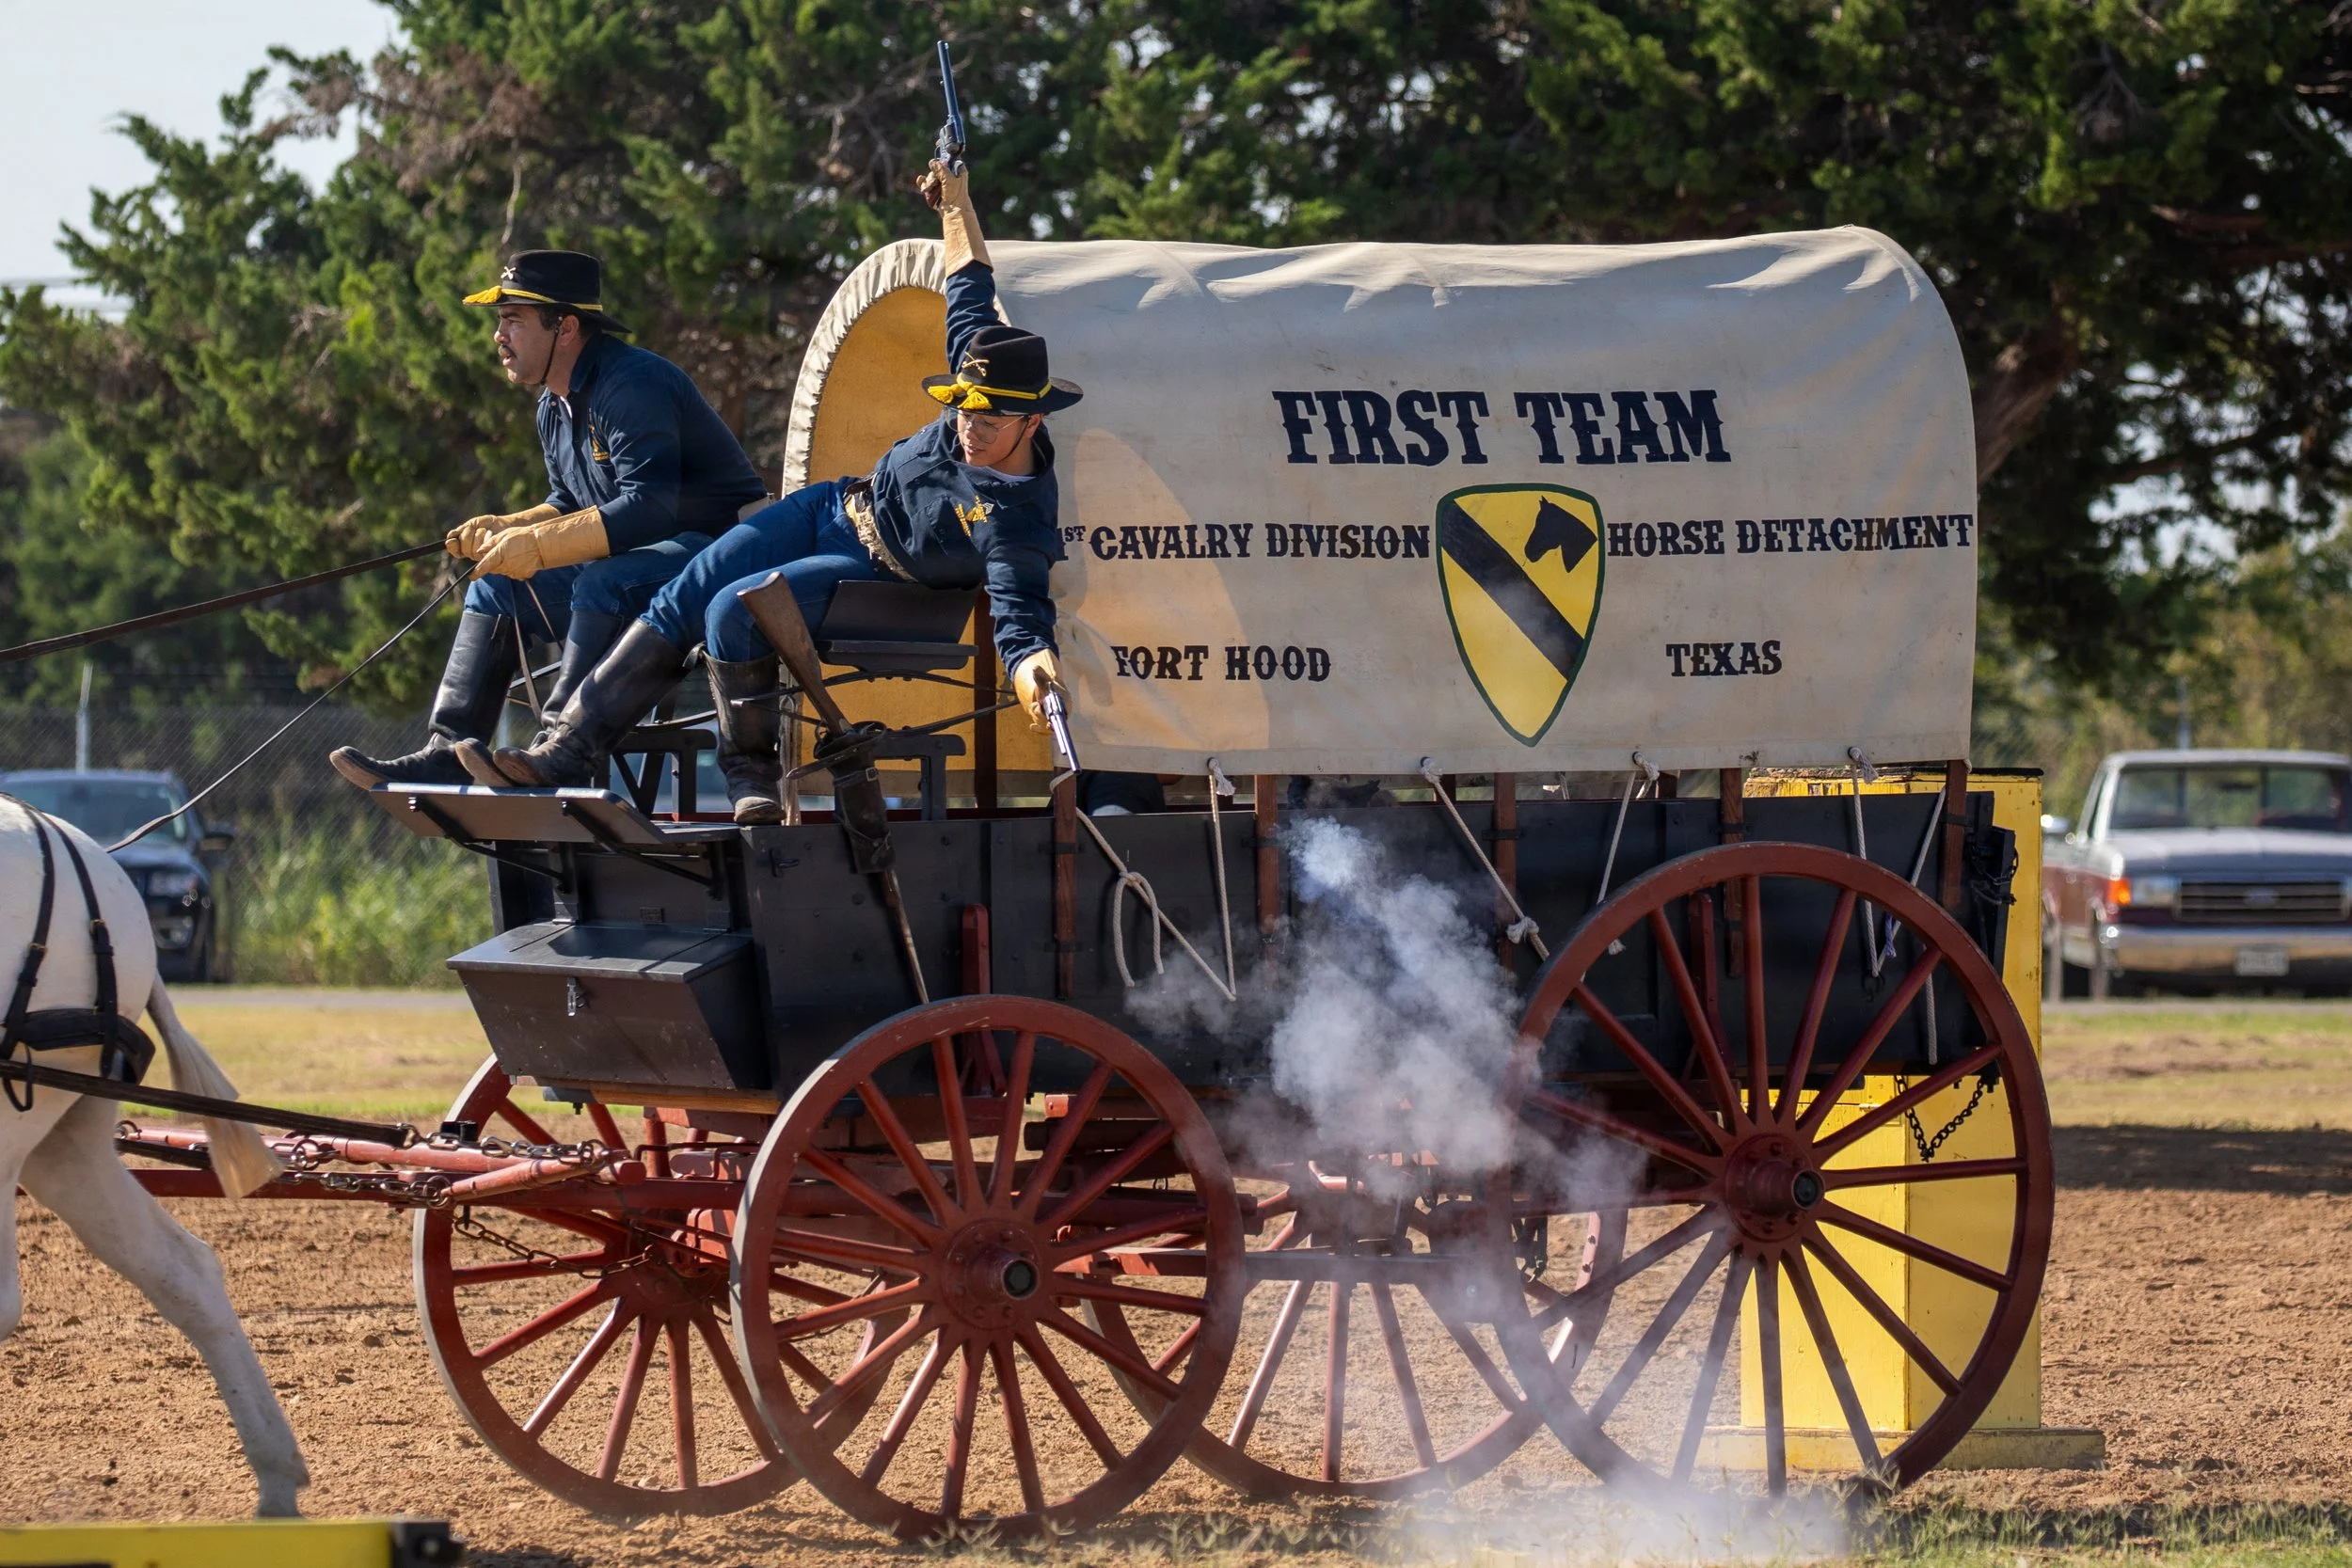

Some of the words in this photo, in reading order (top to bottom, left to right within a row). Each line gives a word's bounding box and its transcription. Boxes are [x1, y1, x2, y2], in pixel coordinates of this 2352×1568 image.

[1272, 390, 1489, 467] FIRST
[1514, 388, 1731, 465] TEAM
[1089, 523, 1253, 561] CAVALRY
[1265, 523, 1430, 559] DIVISION
[1608, 520, 1724, 557] HORSE
[1735, 515, 1973, 553] DETACHMENT
[1111, 645, 1208, 680] FORT
[1225, 645, 1331, 682] HOOD
[1666, 641, 1782, 676] TEXAS
